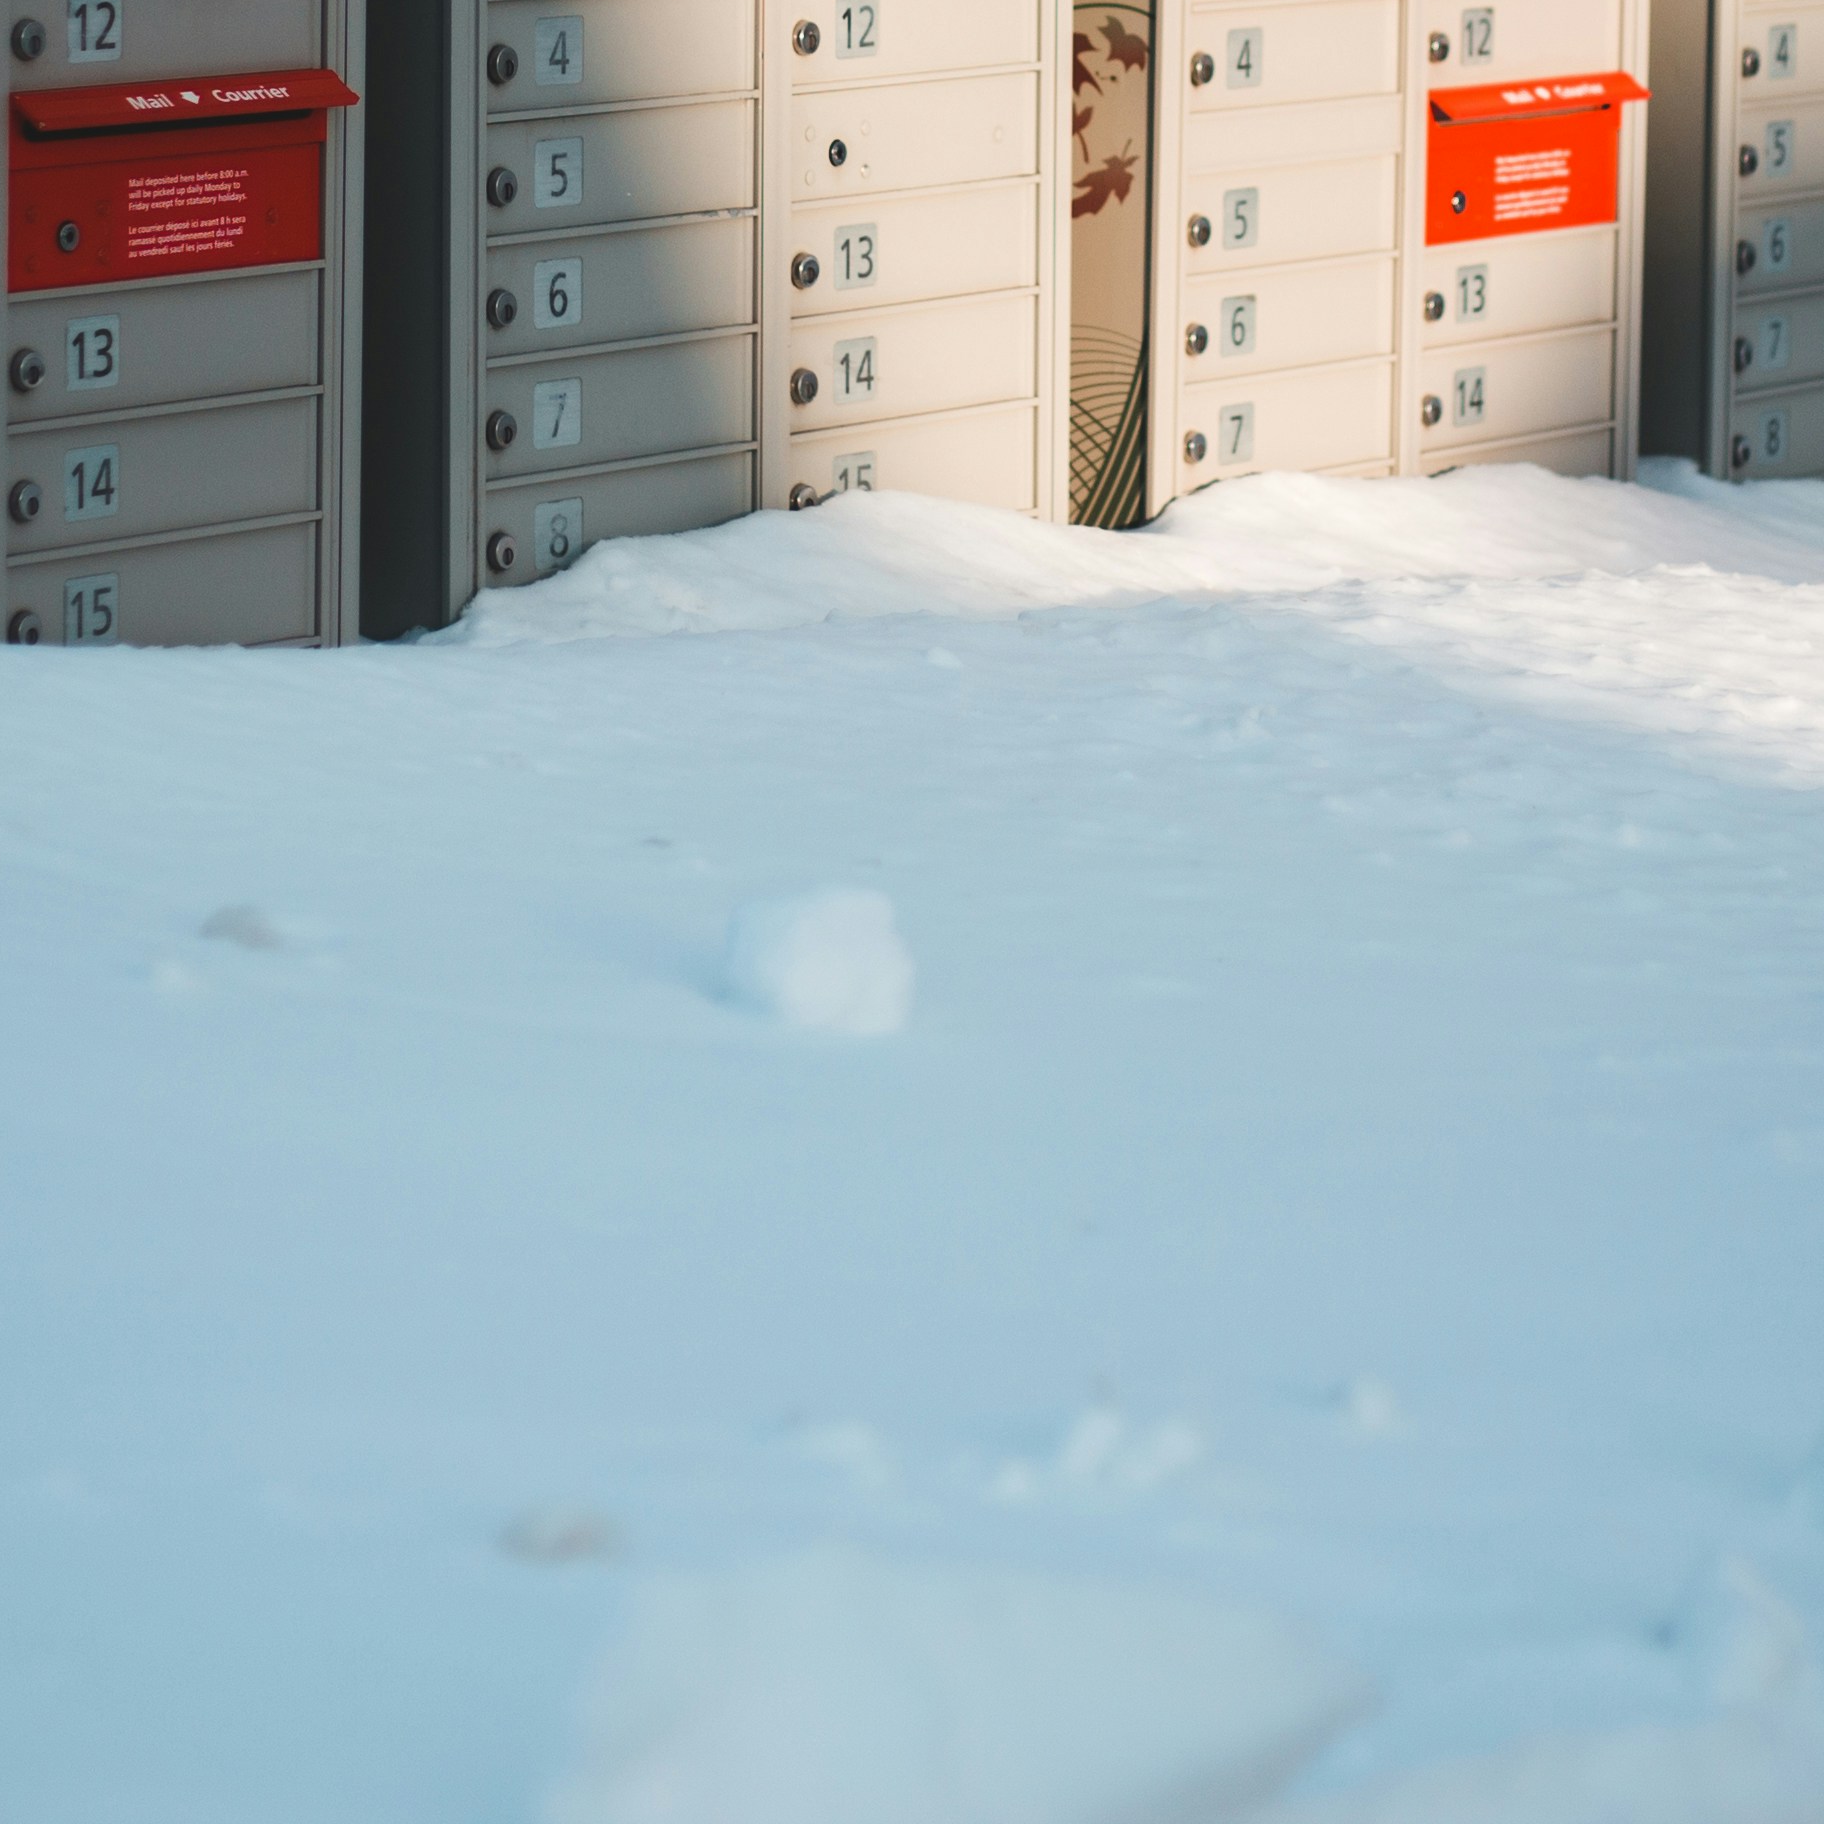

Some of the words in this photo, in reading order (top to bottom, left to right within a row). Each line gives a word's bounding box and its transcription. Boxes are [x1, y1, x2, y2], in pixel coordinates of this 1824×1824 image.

[76, 2, 116, 52] 12
[842, 4, 875, 49] 12
[1465, 18, 1491, 57] 12
[549, 30, 570, 75] 4
[1237, 39, 1252, 78] 4
[1775, 33, 1789, 68] 4
[127, 94, 175, 110] Mail
[211, 85, 290, 103] Courrier
[1773, 129, 1786, 167] 5
[550, 152, 569, 198] 5
[1234, 201, 1248, 240] 5
[840, 235, 874, 280] 13
[1771, 225, 1784, 263] 6
[549, 272, 568, 318] 6
[1460, 275, 1486, 313] 13
[1231, 307, 1245, 346] 6
[72, 328, 114, 379] 13
[840, 349, 874, 394] 14
[549, 392, 568, 438] 7
[1458, 377, 1484, 416] 14
[1230, 415, 1244, 454] 7
[72, 458, 115, 507] 14
[549, 513, 569, 559] 8
[71, 587, 112, 637] 15
